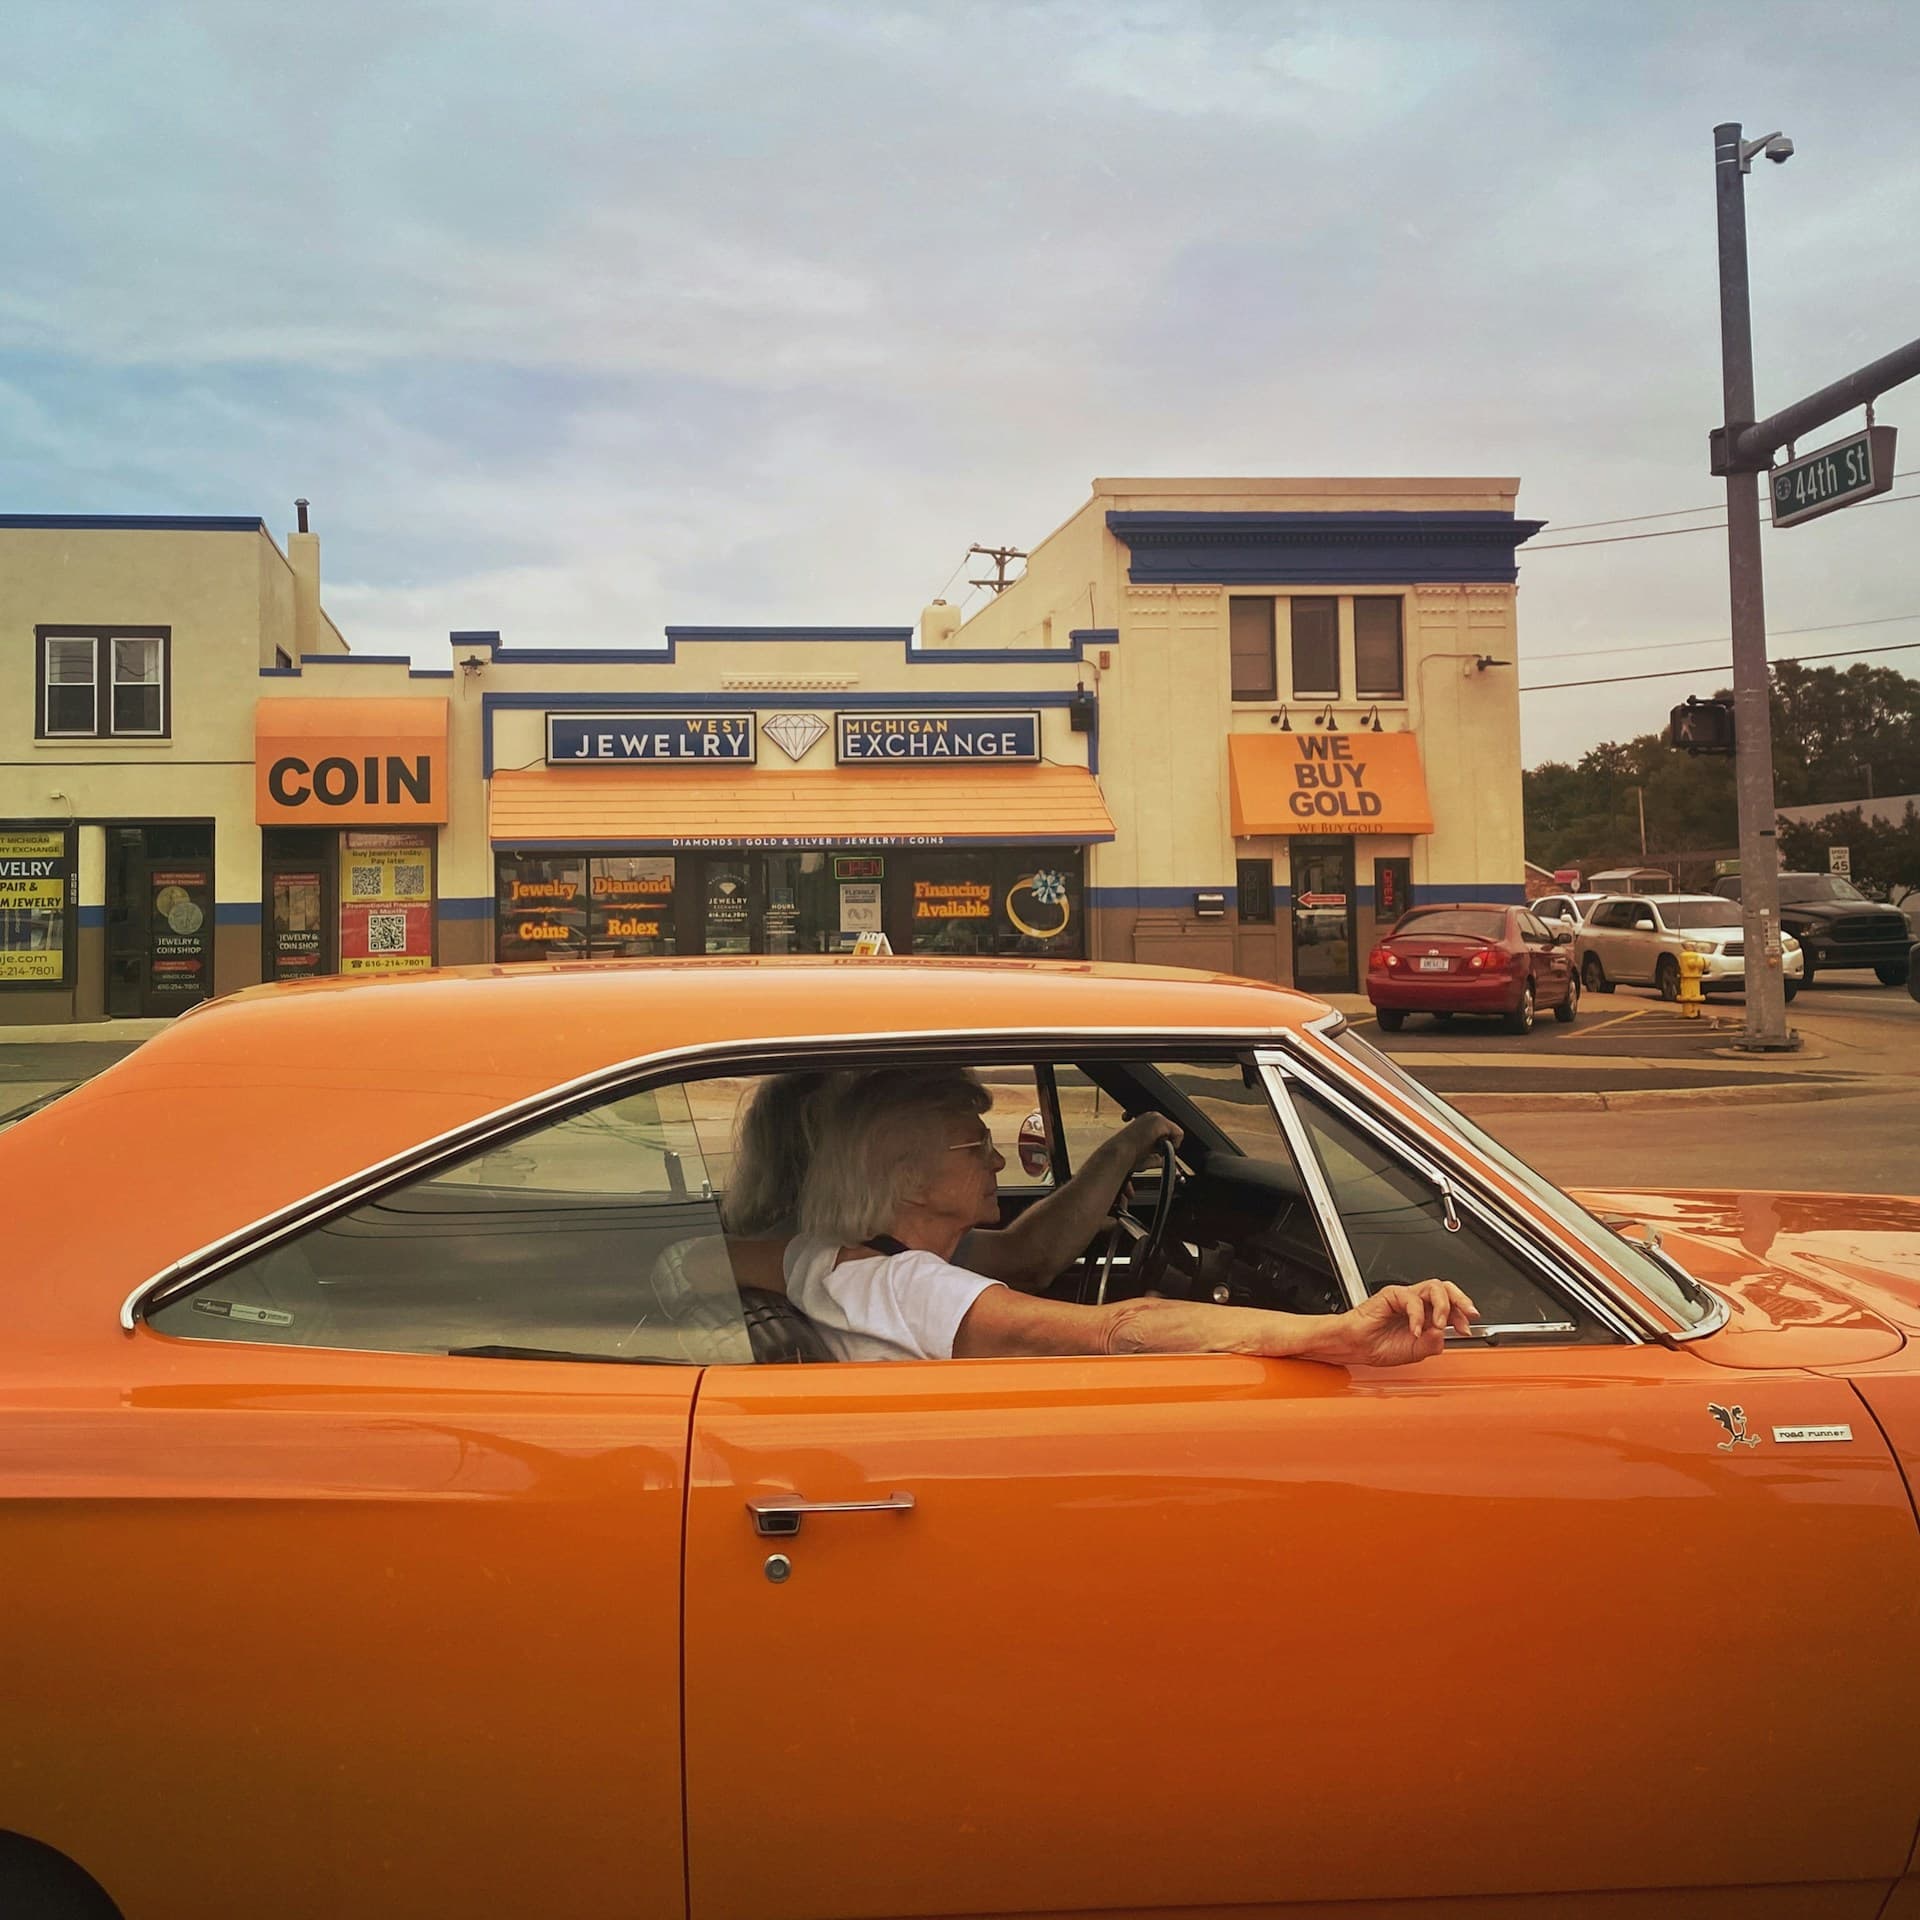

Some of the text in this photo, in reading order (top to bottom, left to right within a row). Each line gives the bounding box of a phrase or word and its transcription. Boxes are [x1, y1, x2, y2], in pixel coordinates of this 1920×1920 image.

[1796, 445, 1866, 504] 44th St
[686, 720, 746, 733] WEST
[846, 720, 948, 733] MICHIGAN
[575, 734, 745, 757] JEWELRY
[847, 733, 1017, 756] EXCHANGE
[1296, 736, 1353, 761] WE
[269, 755, 431, 806] COIN
[1294, 763, 1366, 788] BUY
[1288, 791, 1382, 817] GOLD
[672, 837, 945, 847] DIAMONDS GOLD & SILVER JEWELRY COINS
[1832, 861, 1849, 871] 45
[29, 882, 38, 892] &
[512, 880, 577, 900] Jewelry
[594, 875, 672, 894] Diamond
[913, 881, 991, 900] Financing
[12, 897, 62, 908] JEWELRY
[917, 901, 991, 917] Available
[519, 921, 569, 940] Coins
[608, 918, 659, 936] Rolex
[0, 953, 48, 965] je.com
